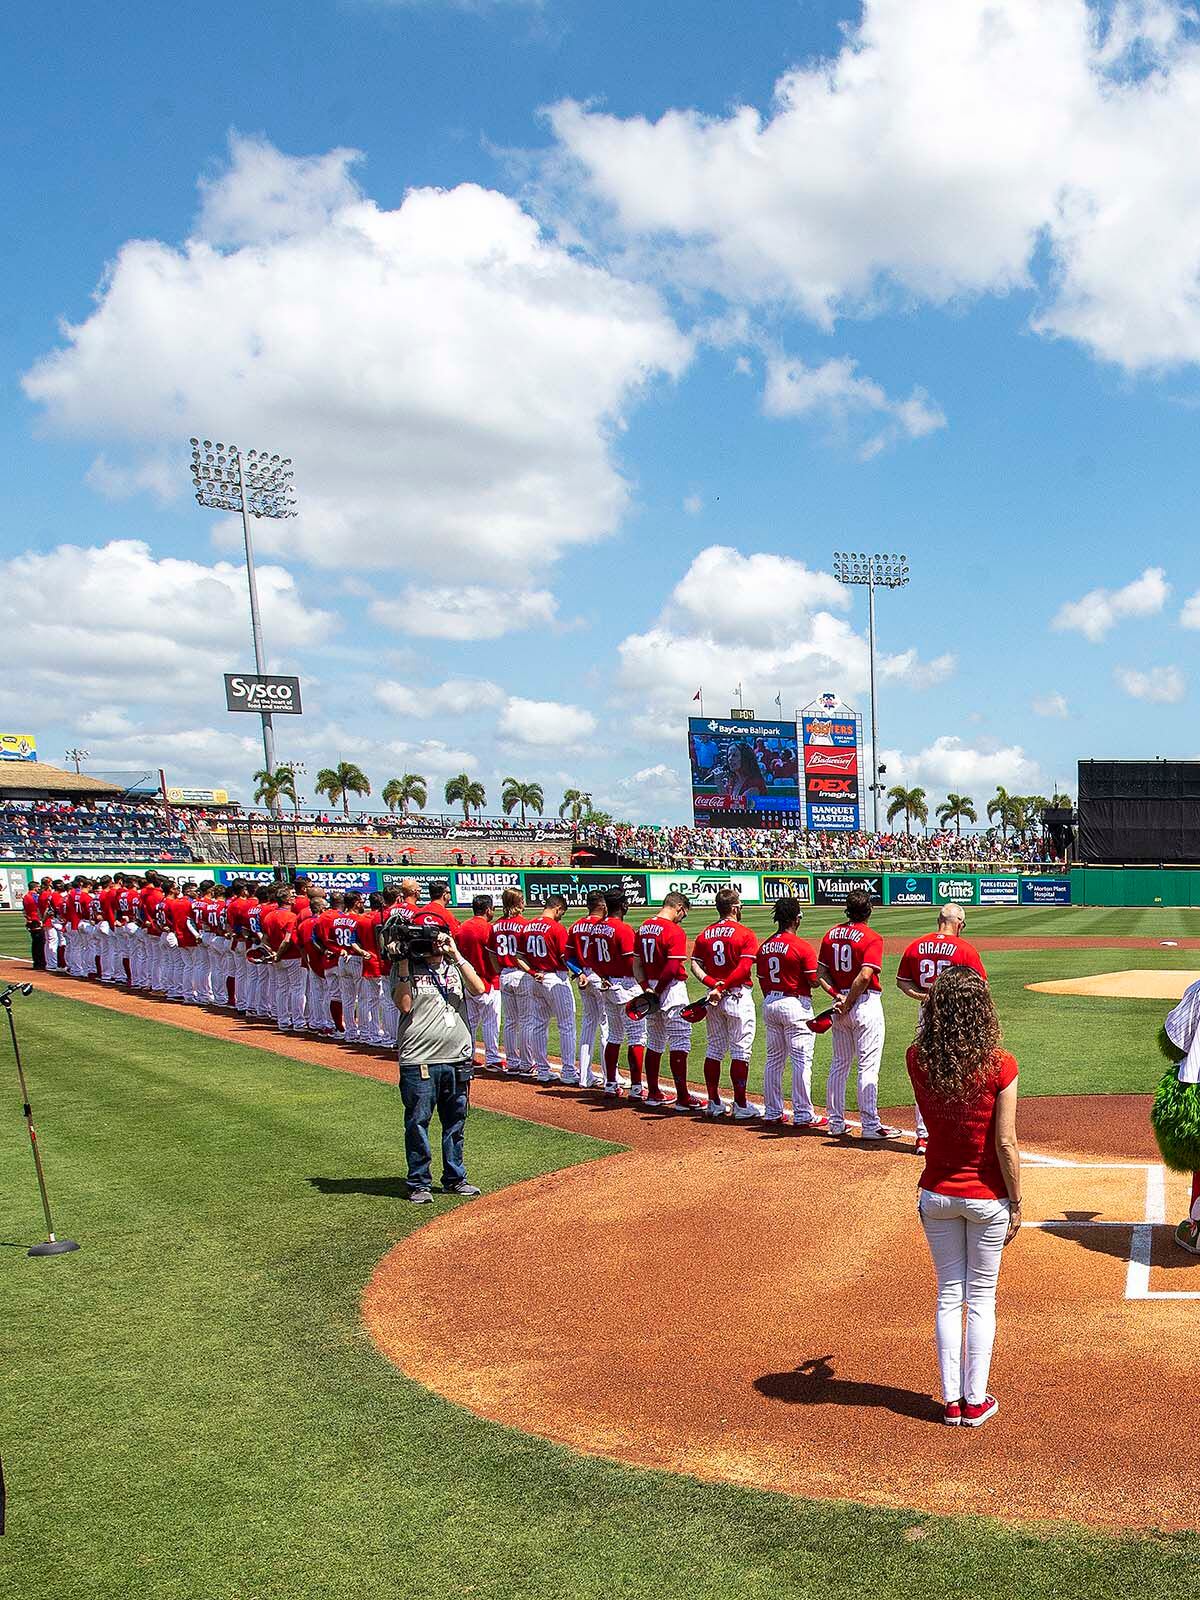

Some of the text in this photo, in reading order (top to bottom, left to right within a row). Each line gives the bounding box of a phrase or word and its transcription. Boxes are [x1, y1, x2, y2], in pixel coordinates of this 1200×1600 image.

[231, 677, 292, 701] Sysco
[719, 725, 780, 736] BayCare Ballpark
[812, 755, 850, 764] Budweiser
[808, 779, 852, 792] DEX
[811, 806, 854, 815] BANQUET
[812, 814, 854, 823] MASTERS
[217, 823, 249, 831] CARLOS
[306, 872, 370, 882] DELCO'S
[457, 873, 518, 885] INJURED?
[764, 882, 809, 898] CLEAR SKY
[817, 878, 878, 893] MaintenX
[938, 881, 974, 898] Times
[493, 922, 523, 933] WILLIAMS
[704, 927, 735, 939] HARPER
[496, 934, 518, 956] 30
[527, 935, 547, 957] 40
[580, 936, 590, 958] 7
[641, 938, 656, 963] 17
[762, 942, 789, 955] SEGURA
[918, 941, 957, 956] GIRARDI
[712, 940, 726, 966] 3
[832, 943, 852, 972] 19
[768, 956, 781, 983] 2
